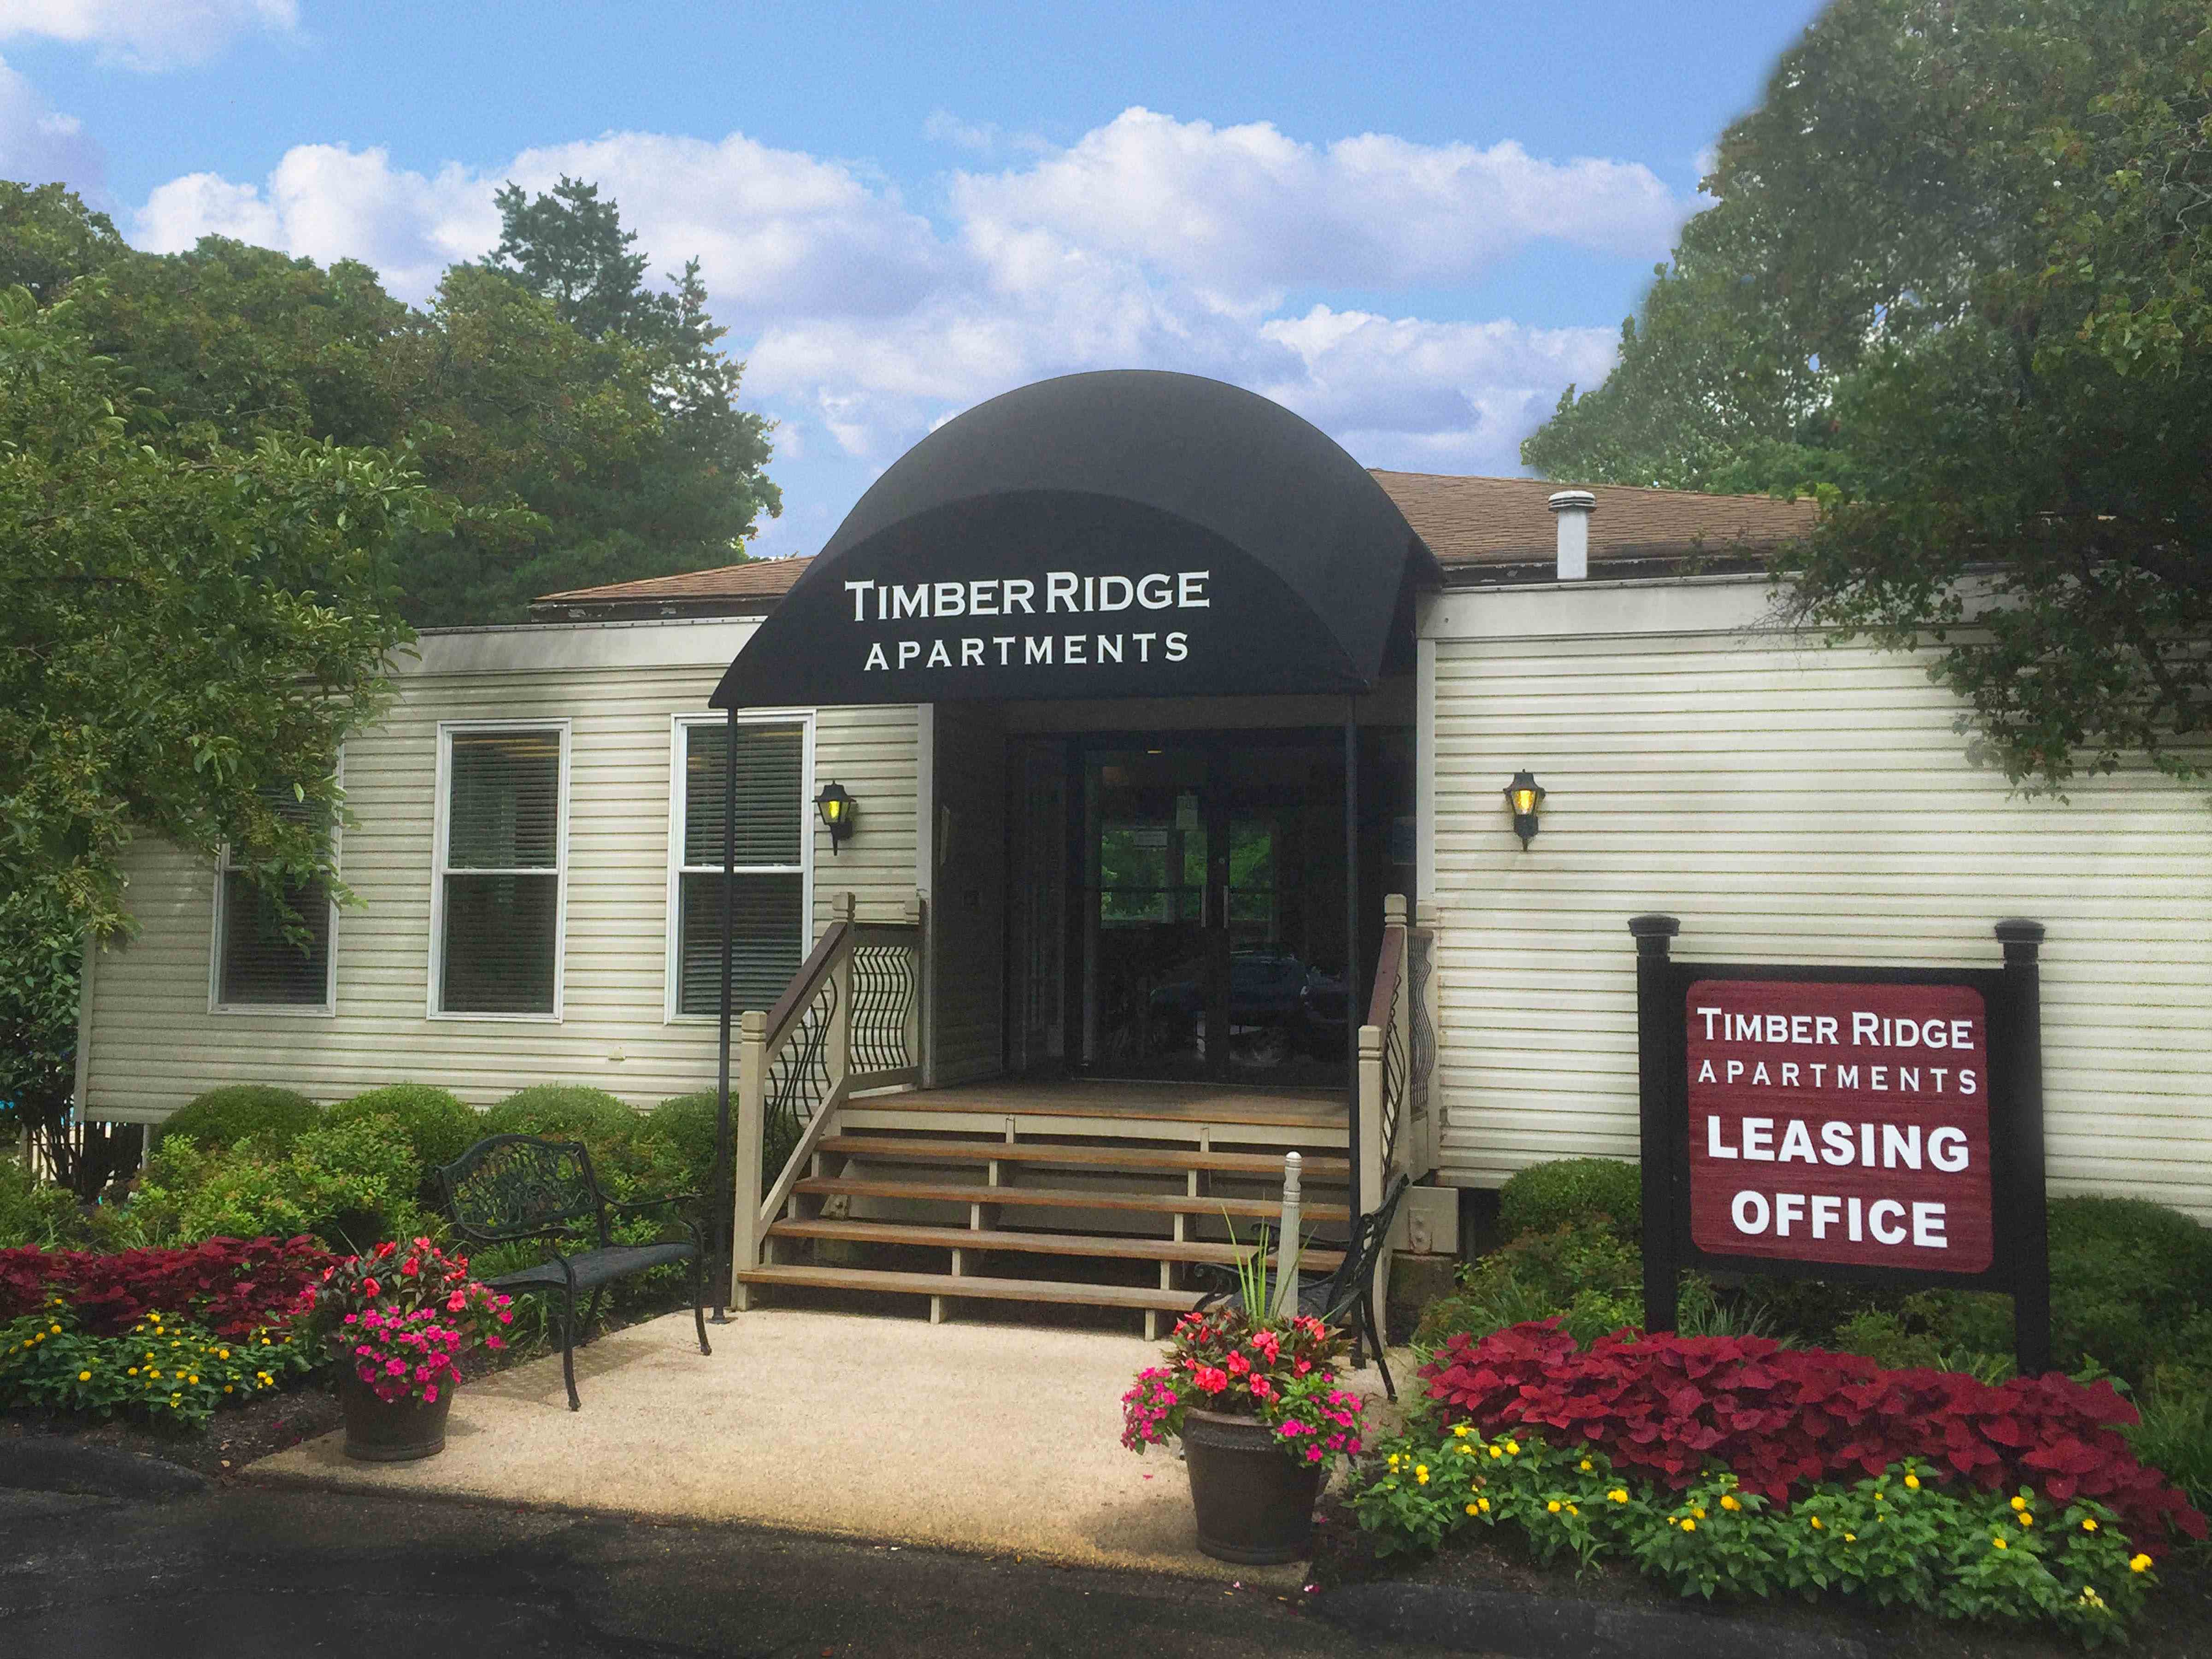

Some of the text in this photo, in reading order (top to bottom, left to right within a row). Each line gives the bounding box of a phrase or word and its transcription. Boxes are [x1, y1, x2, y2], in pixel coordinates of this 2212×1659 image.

[844, 570, 1210, 622] TIMBER RIDGE
[863, 631, 1188, 671] APARTMENTS
[1696, 1006, 1975, 1050] TIMBER RIDGE
[1698, 1059, 1977, 1095] APARTMENTS
[1707, 1115, 1969, 1172] LEASING
[1731, 1189, 1948, 1248] OFFICE
